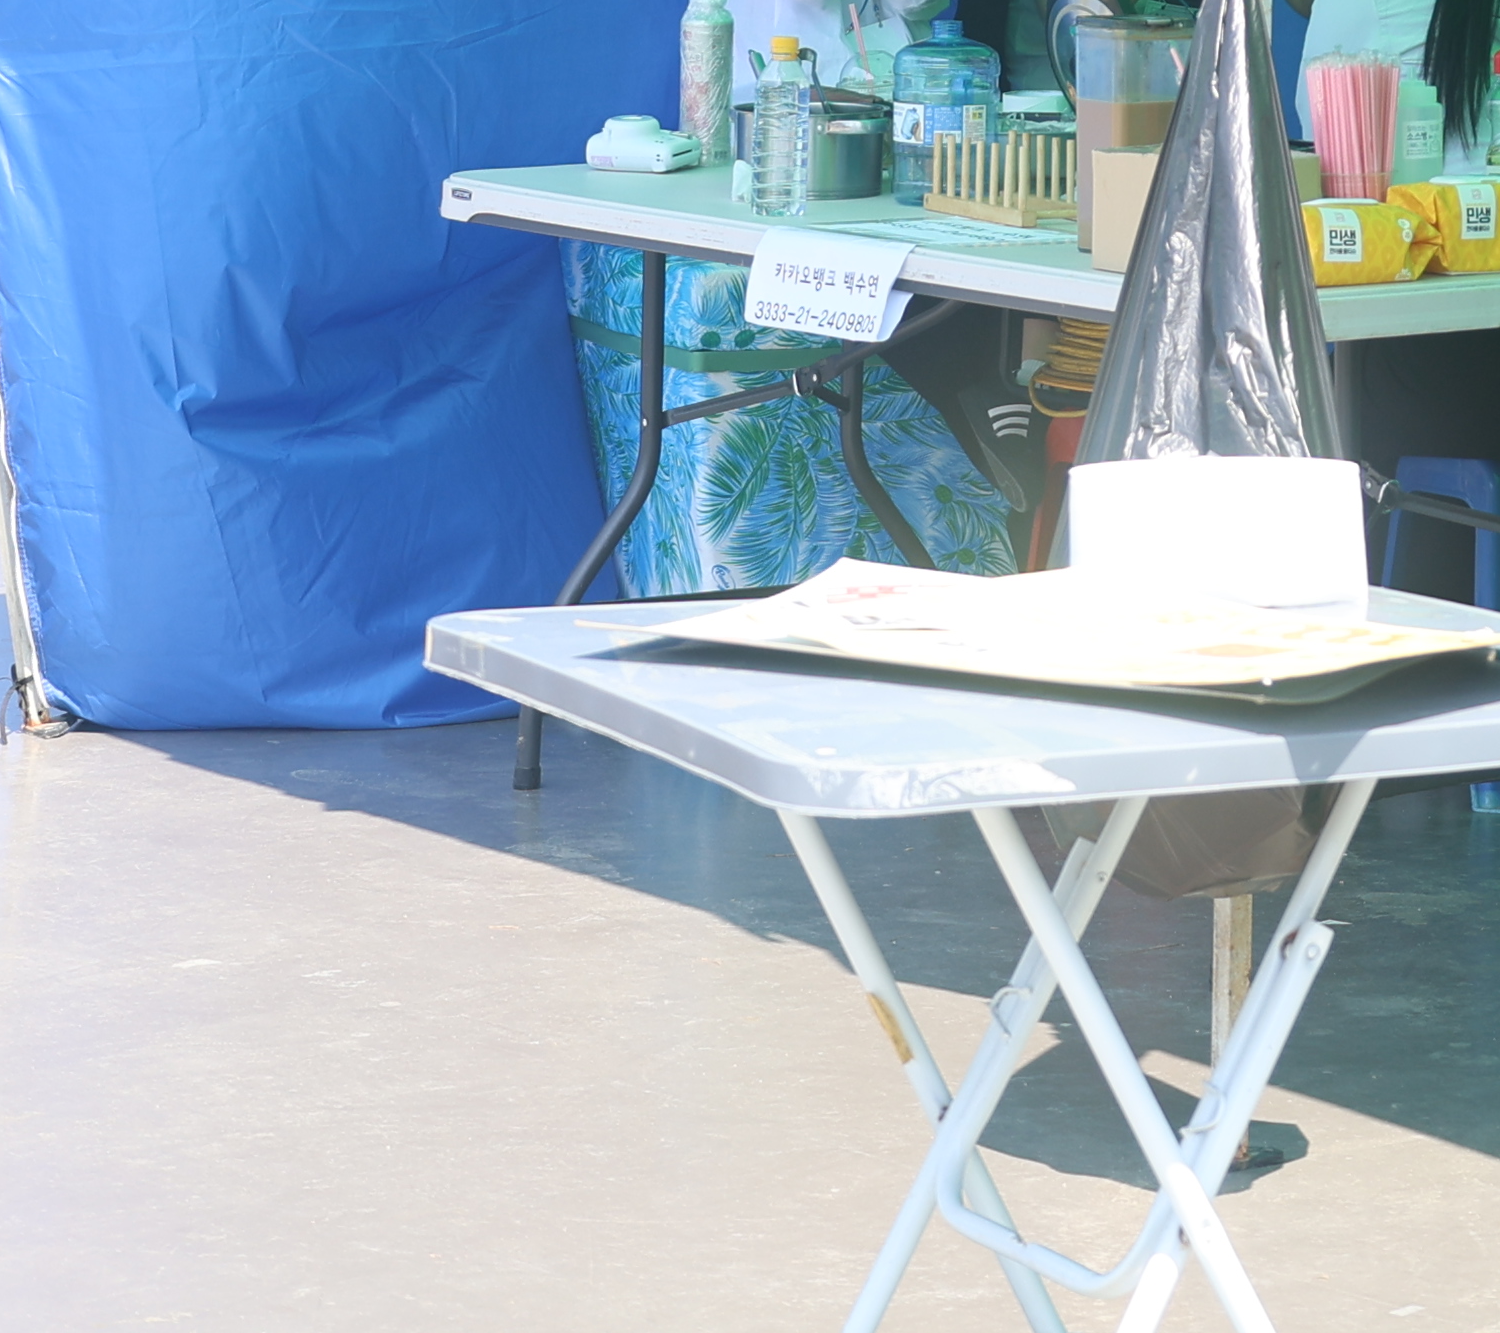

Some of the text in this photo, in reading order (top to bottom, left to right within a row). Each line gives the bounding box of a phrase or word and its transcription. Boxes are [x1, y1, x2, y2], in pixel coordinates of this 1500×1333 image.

[1466, 206, 1491, 224] 민생
[1329, 229, 1357, 247] 민생
[774, 262, 880, 298] 카카오뱅크 백수연
